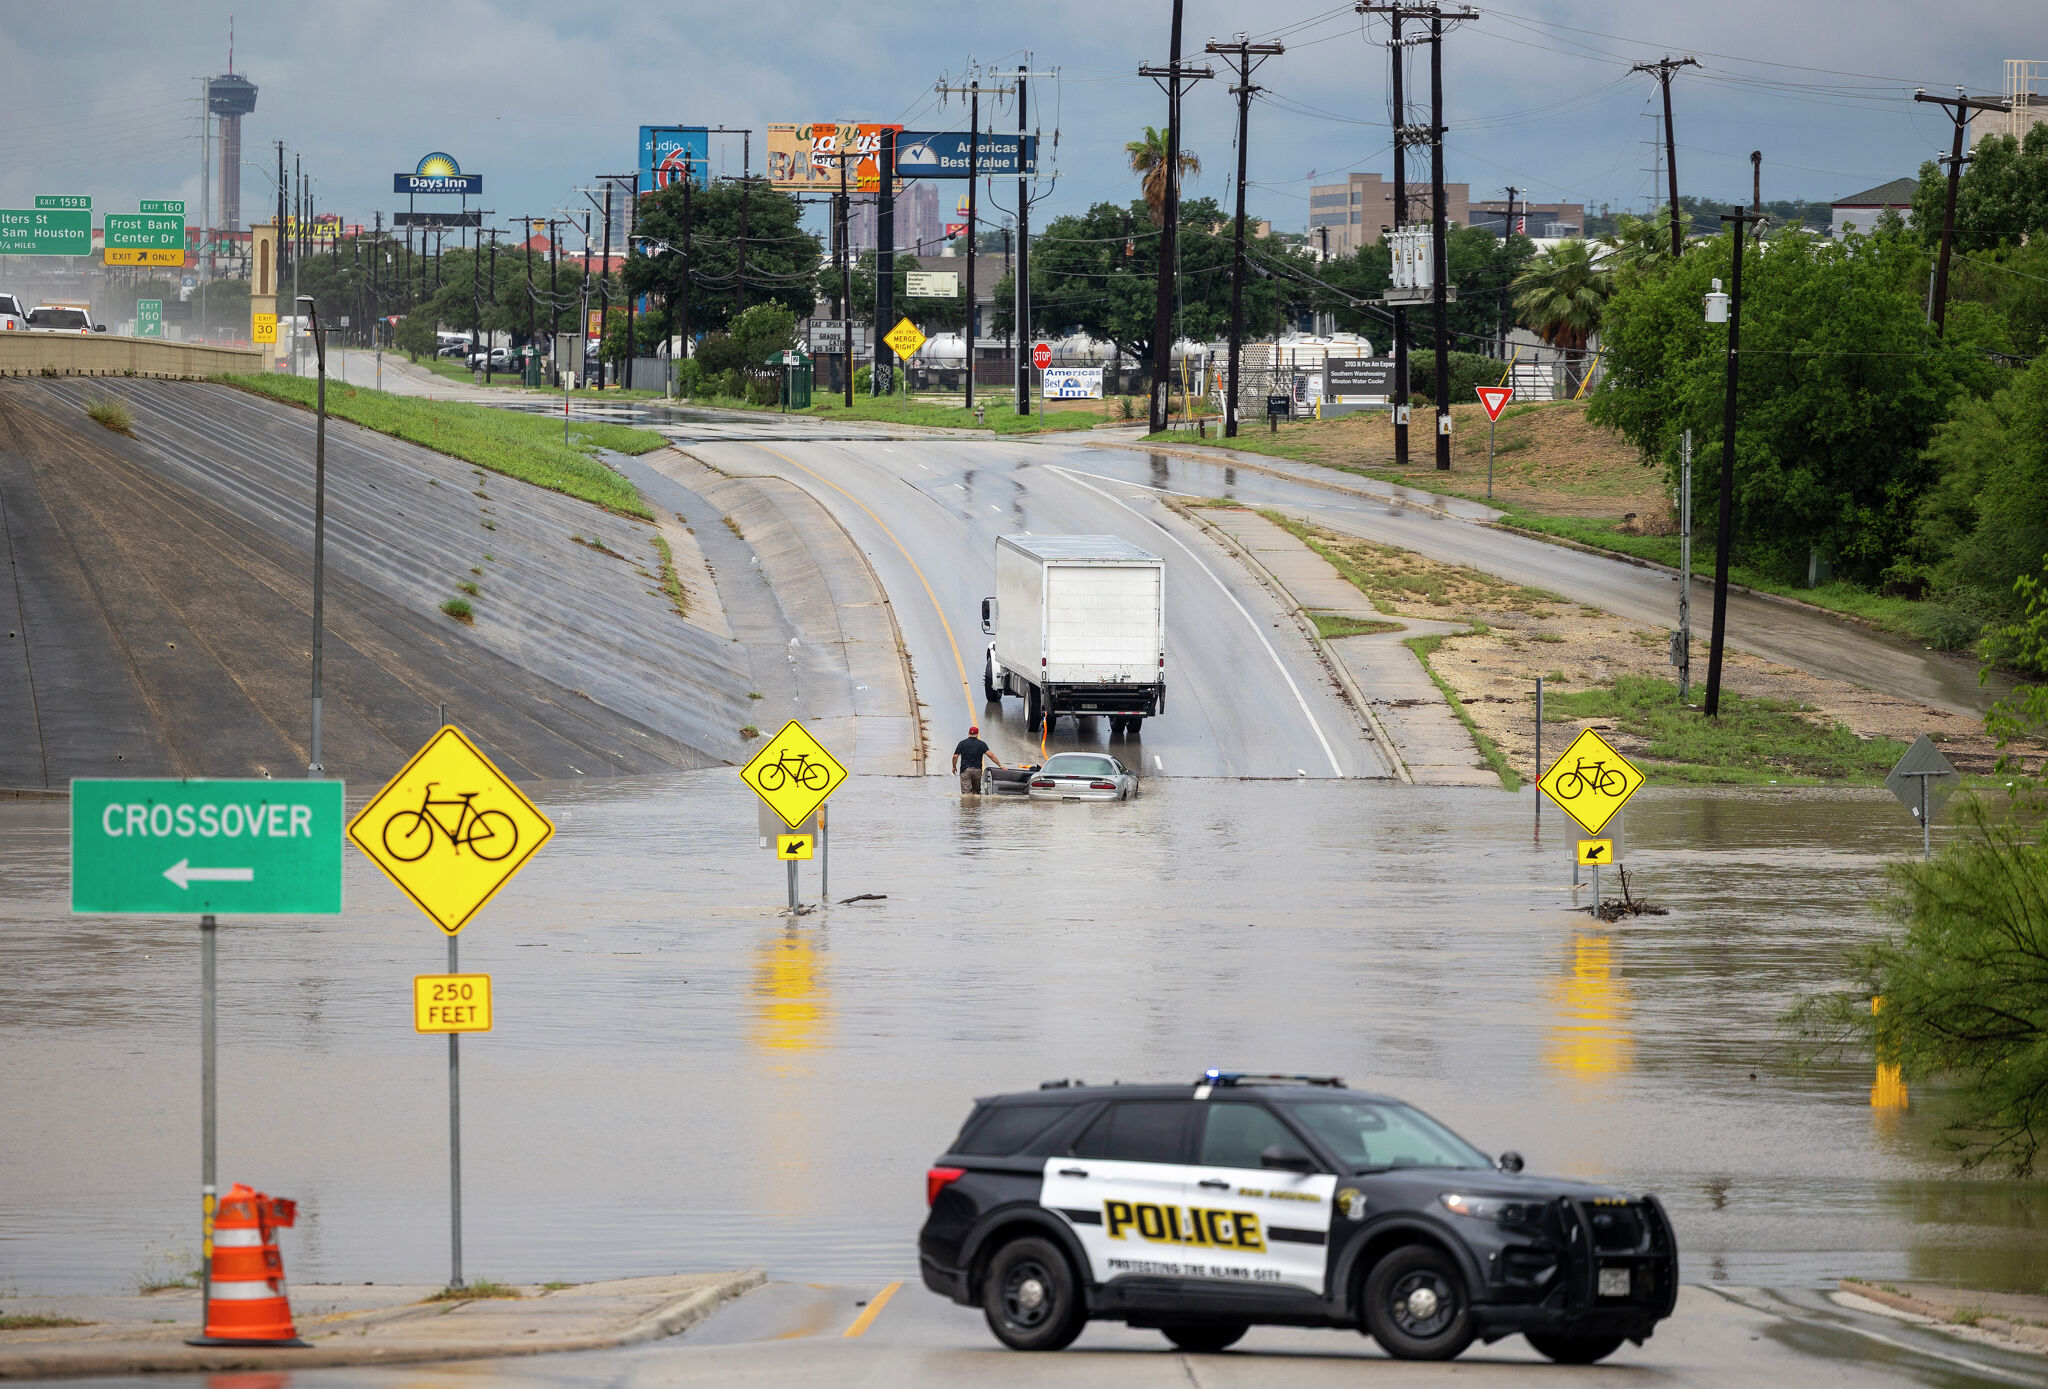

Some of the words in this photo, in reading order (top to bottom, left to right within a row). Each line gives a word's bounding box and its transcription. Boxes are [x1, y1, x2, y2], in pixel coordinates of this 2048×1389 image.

[941, 157, 970, 168] Best
[1014, 157, 1034, 168] In
[409, 177, 443, 189] Days
[444, 178, 467, 188] Inn
[163, 203, 182, 212] 160
[36, 214, 48, 224] St
[111, 220, 141, 229] Frost
[148, 220, 178, 230] Bank
[2, 228, 28, 237] Sam
[34, 228, 85, 238] Houston
[114, 233, 155, 243] Center
[161, 234, 175, 243] Dr
[140, 312, 159, 320] 160
[257, 325, 273, 334] 30
[1034, 351, 1050, 362] STOP
[1044, 378, 1060, 388] Best
[1059, 387, 1088, 396] Inn
[102, 803, 312, 838] CROSSOVER
[432, 984, 473, 1001] 250
[428, 1006, 477, 1024] FEET
[1104, 1200, 1266, 1253] POLICE
[1107, 1258, 1179, 1275] PROTECTING
[1183, 1264, 1205, 1276] THE
[1209, 1266, 1250, 1279] ALAMO
[1254, 1269, 1281, 1282] CITY
